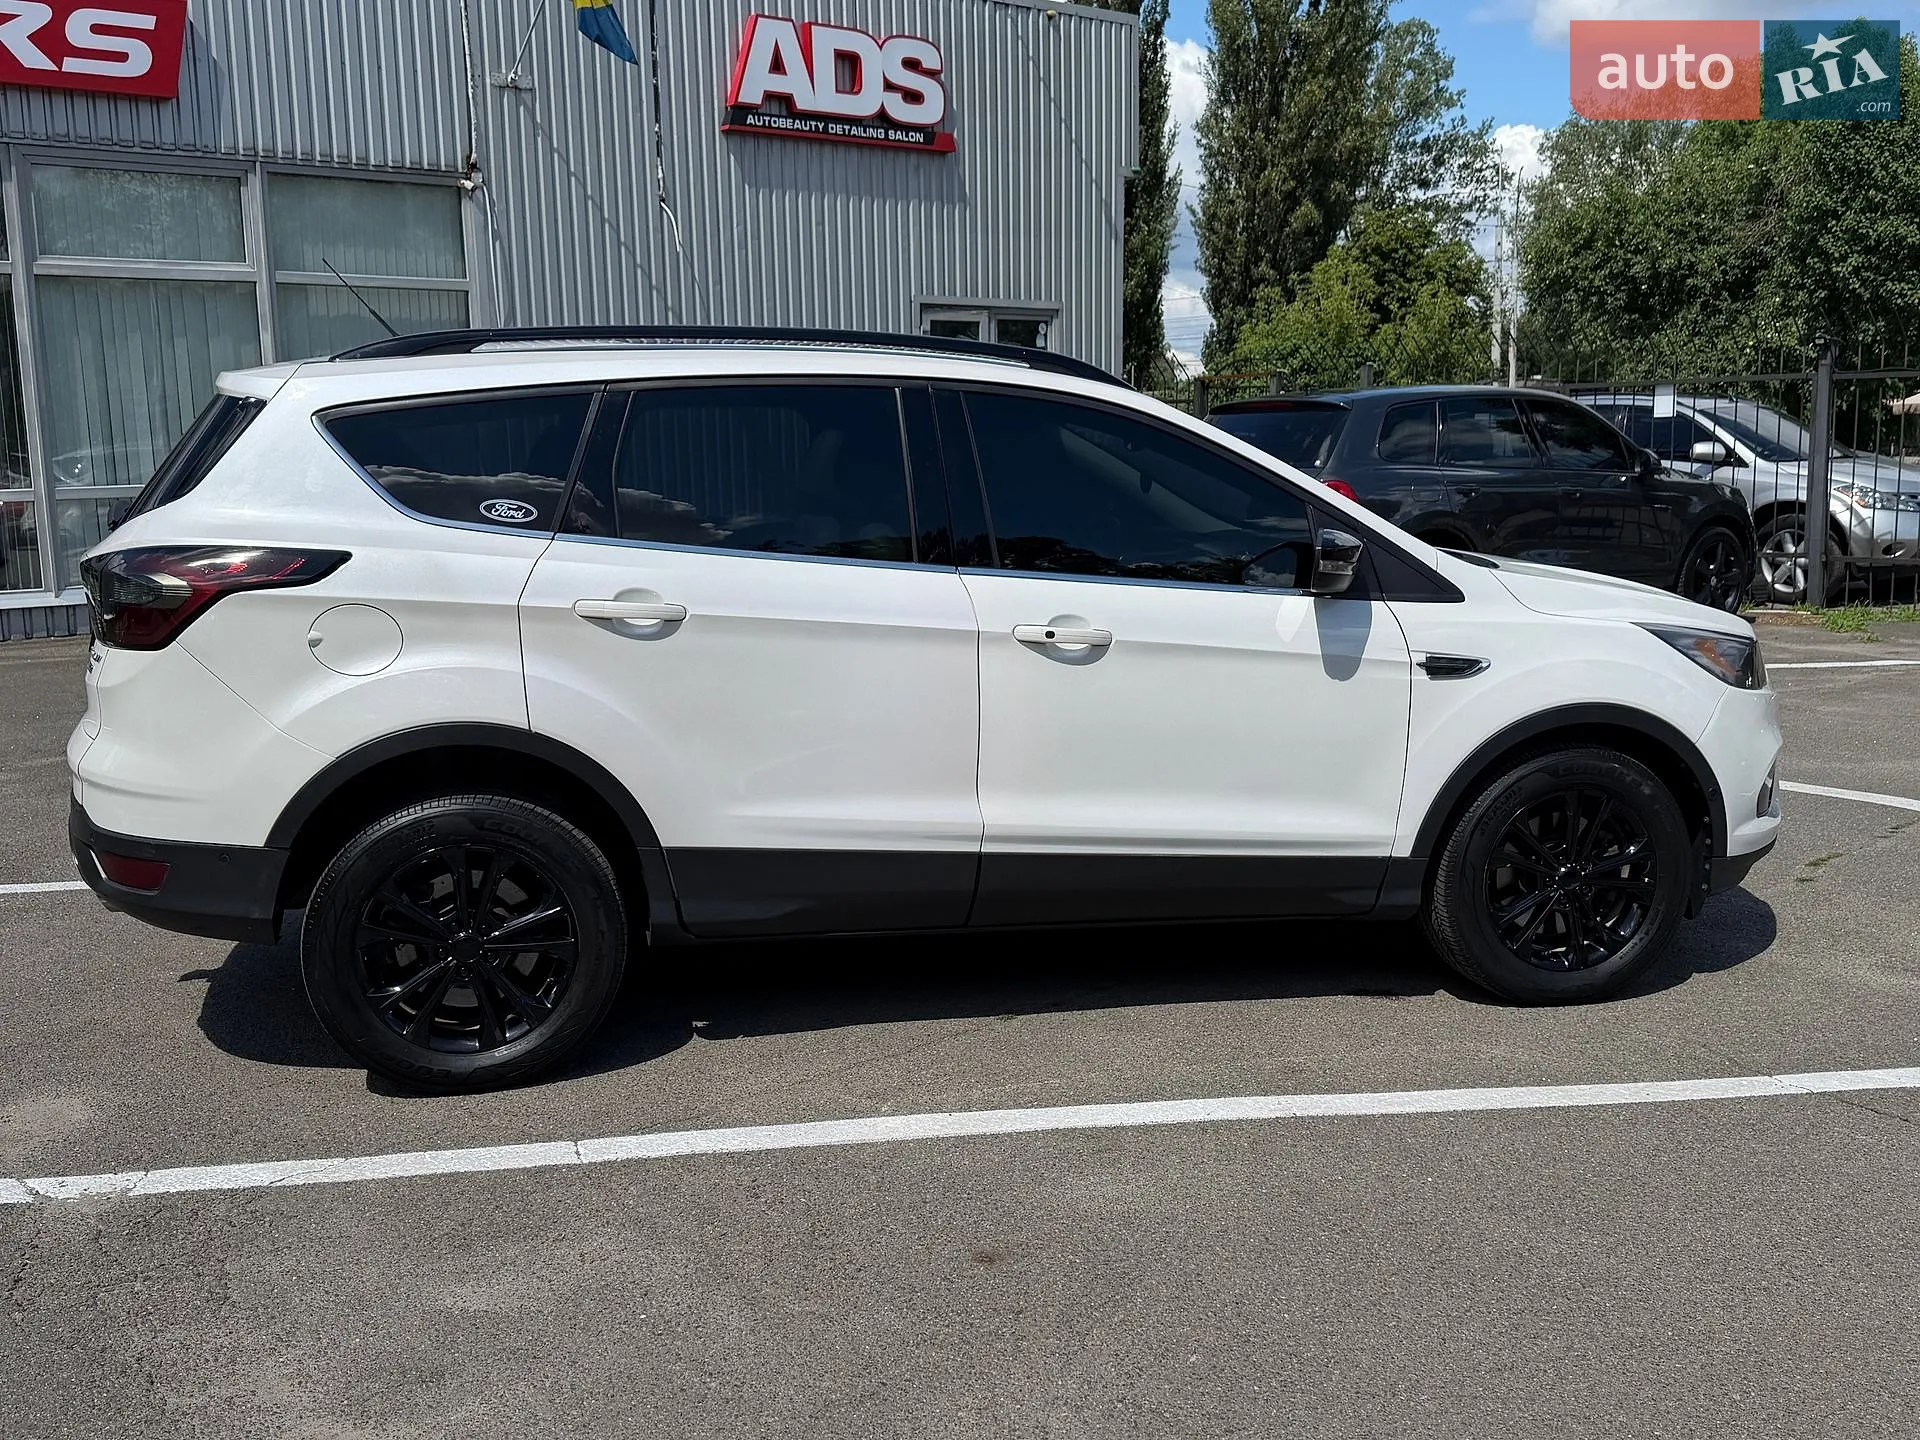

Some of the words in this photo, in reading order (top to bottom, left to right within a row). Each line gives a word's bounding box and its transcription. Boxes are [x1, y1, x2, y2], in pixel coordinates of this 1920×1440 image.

[736, 15, 946, 126] ADS
[746, 114, 825, 133] AUTOBEAUTY
[828, 123, 885, 140] DETAILING
[888, 130, 924, 143] SALON
[491, 502, 526, 519] Ford
